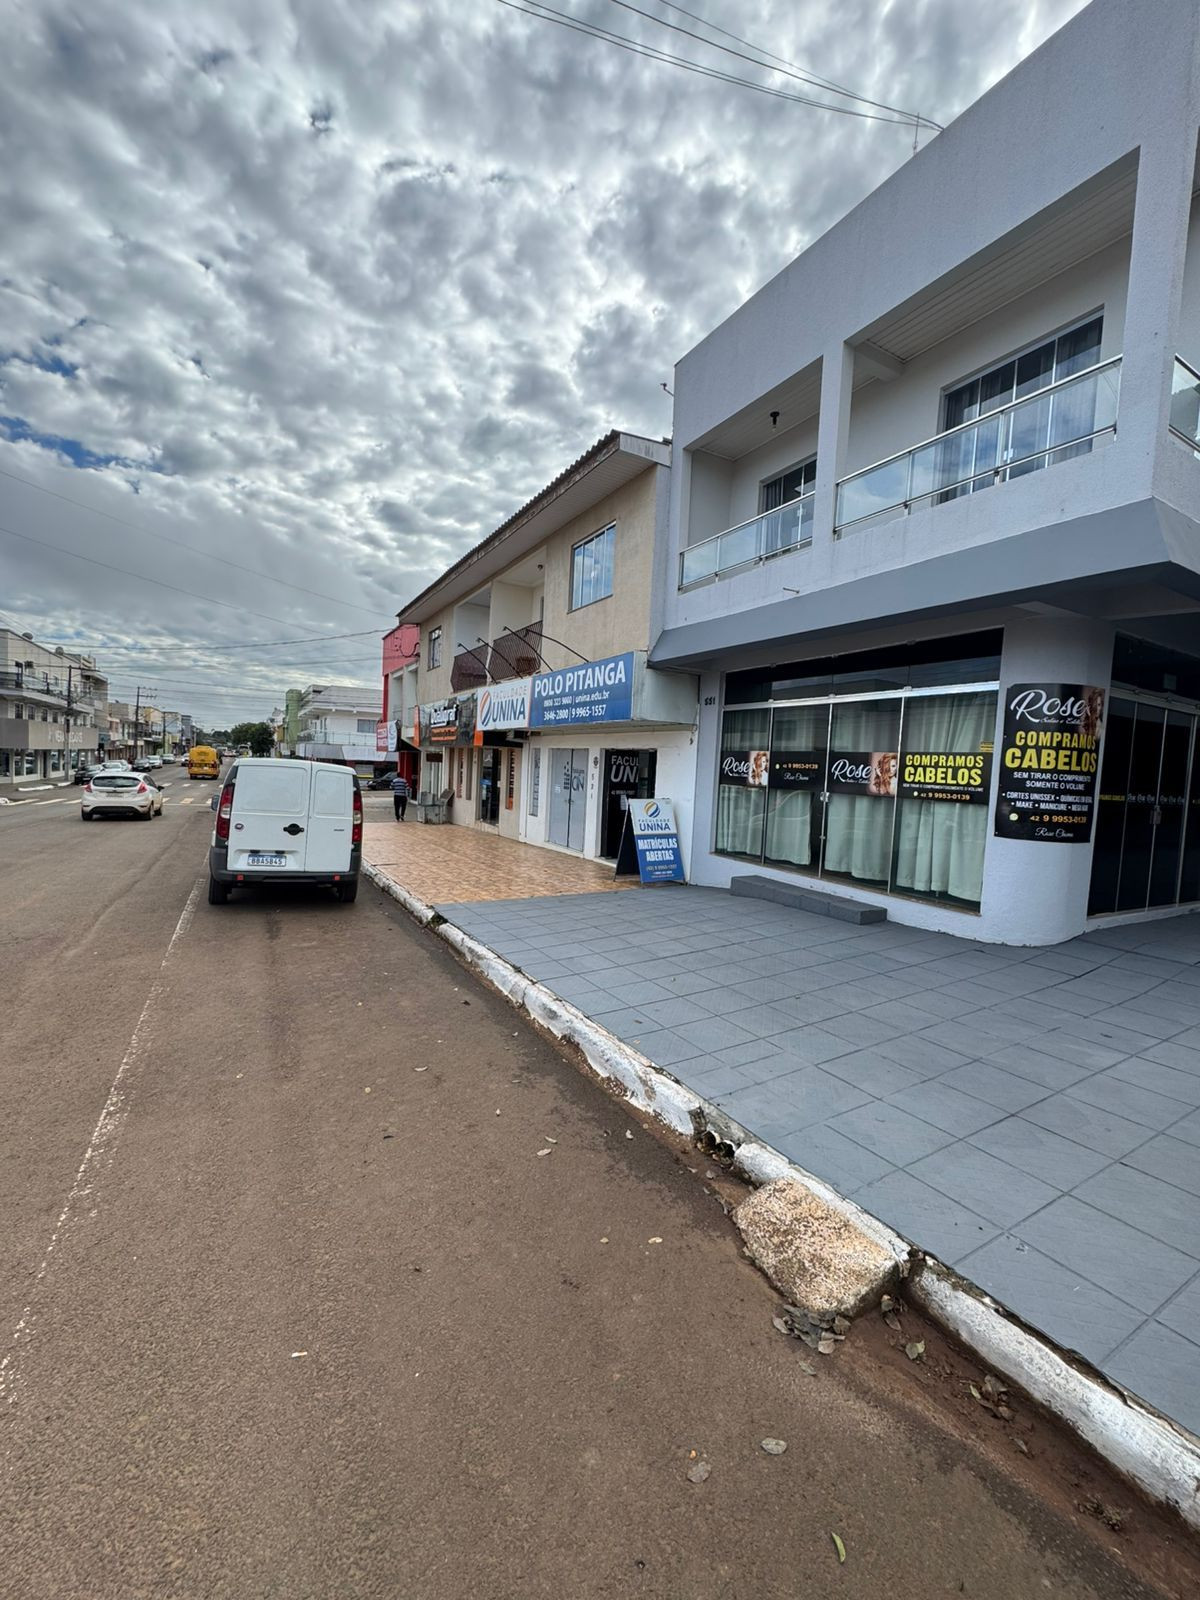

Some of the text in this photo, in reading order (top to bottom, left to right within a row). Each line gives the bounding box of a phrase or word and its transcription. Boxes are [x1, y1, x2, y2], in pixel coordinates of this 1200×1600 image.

[534, 660, 626, 698] POLO PITANGA
[492, 685, 527, 699] FACULDADE
[575, 689, 610, 703] unina.edu.br
[492, 697, 526, 722] UNINA
[576, 704, 607, 718] 9965-1557
[1010, 689, 1090, 723] Rose
[1015, 731, 1096, 751] COMPRAMOS
[722, 756, 750, 776] Rose
[905, 754, 984, 768] COMPRAMOS
[1005, 747, 1097, 773] CABELOS
[831, 758, 872, 783] Rose
[904, 766, 982, 786] CABELOS
[1013, 771, 1029, 779] SEM
[1030, 772, 1051, 780] TIRAR
[1025, 780, 1059, 789] SOMENTE
[934, 792, 970, 800] 9953-0139
[1006, 791, 1029, 800] CORTES
[1030, 792, 1055, 801] UNISSEX
[1015, 801, 1034, 809] MAKE
[1039, 802, 1068, 811] MANICURE
[1042, 814, 1050, 822] 9
[639, 822, 671, 832] UNINA
[637, 836, 678, 850] MATRÍCULAS
[645, 849, 675, 862] ABERTAS
